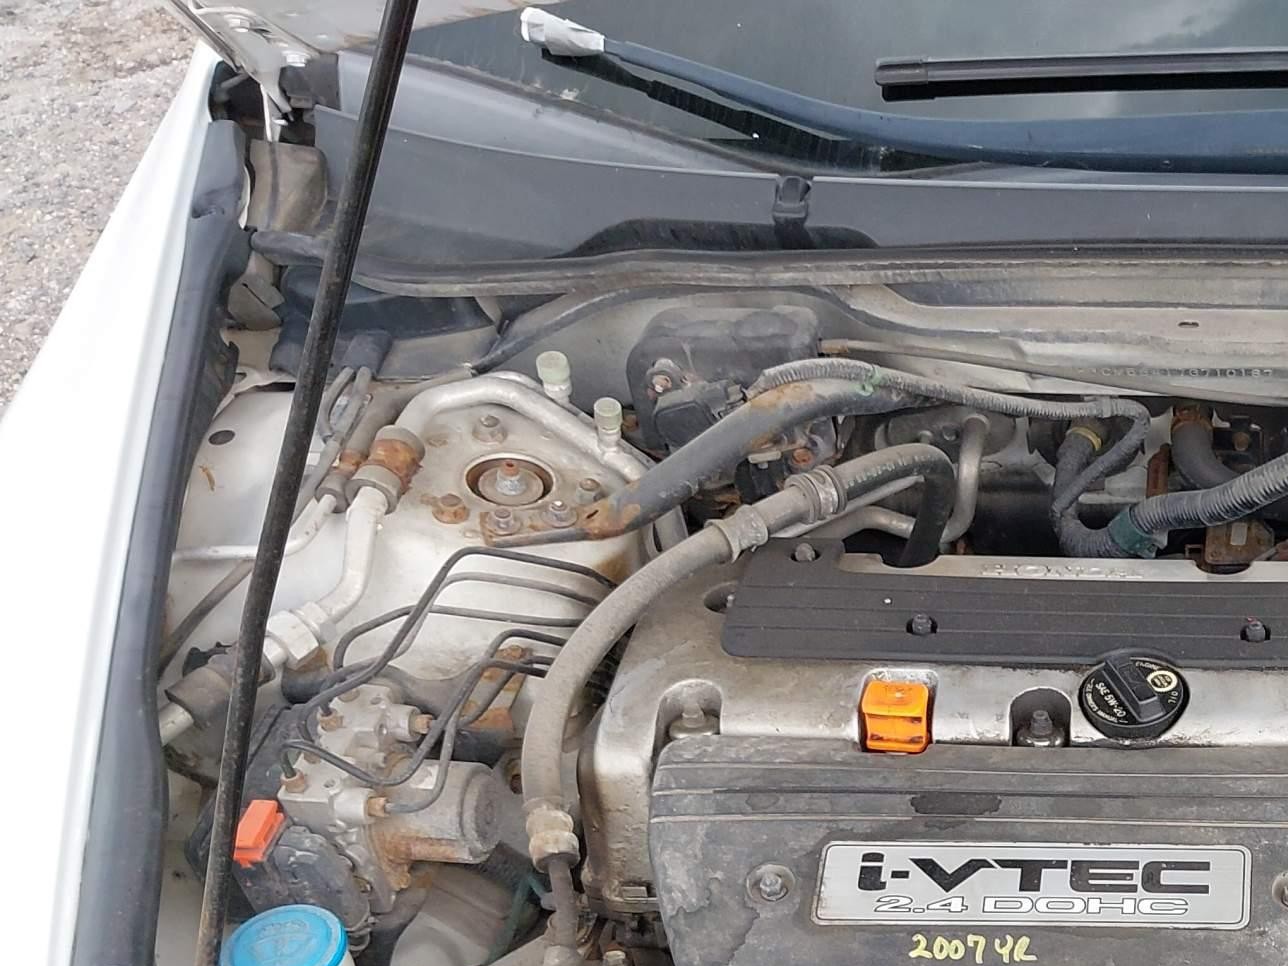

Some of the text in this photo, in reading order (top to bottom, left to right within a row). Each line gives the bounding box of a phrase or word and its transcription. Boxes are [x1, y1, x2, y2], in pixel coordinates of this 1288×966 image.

[1095, 682, 1110, 696] SAE
[1104, 693, 1127, 718] 5W-20
[858, 851, 1211, 895] i-VTEC
[874, 894, 1188, 916] 2.4 DOHC
[908, 933, 986, 964] 2007
